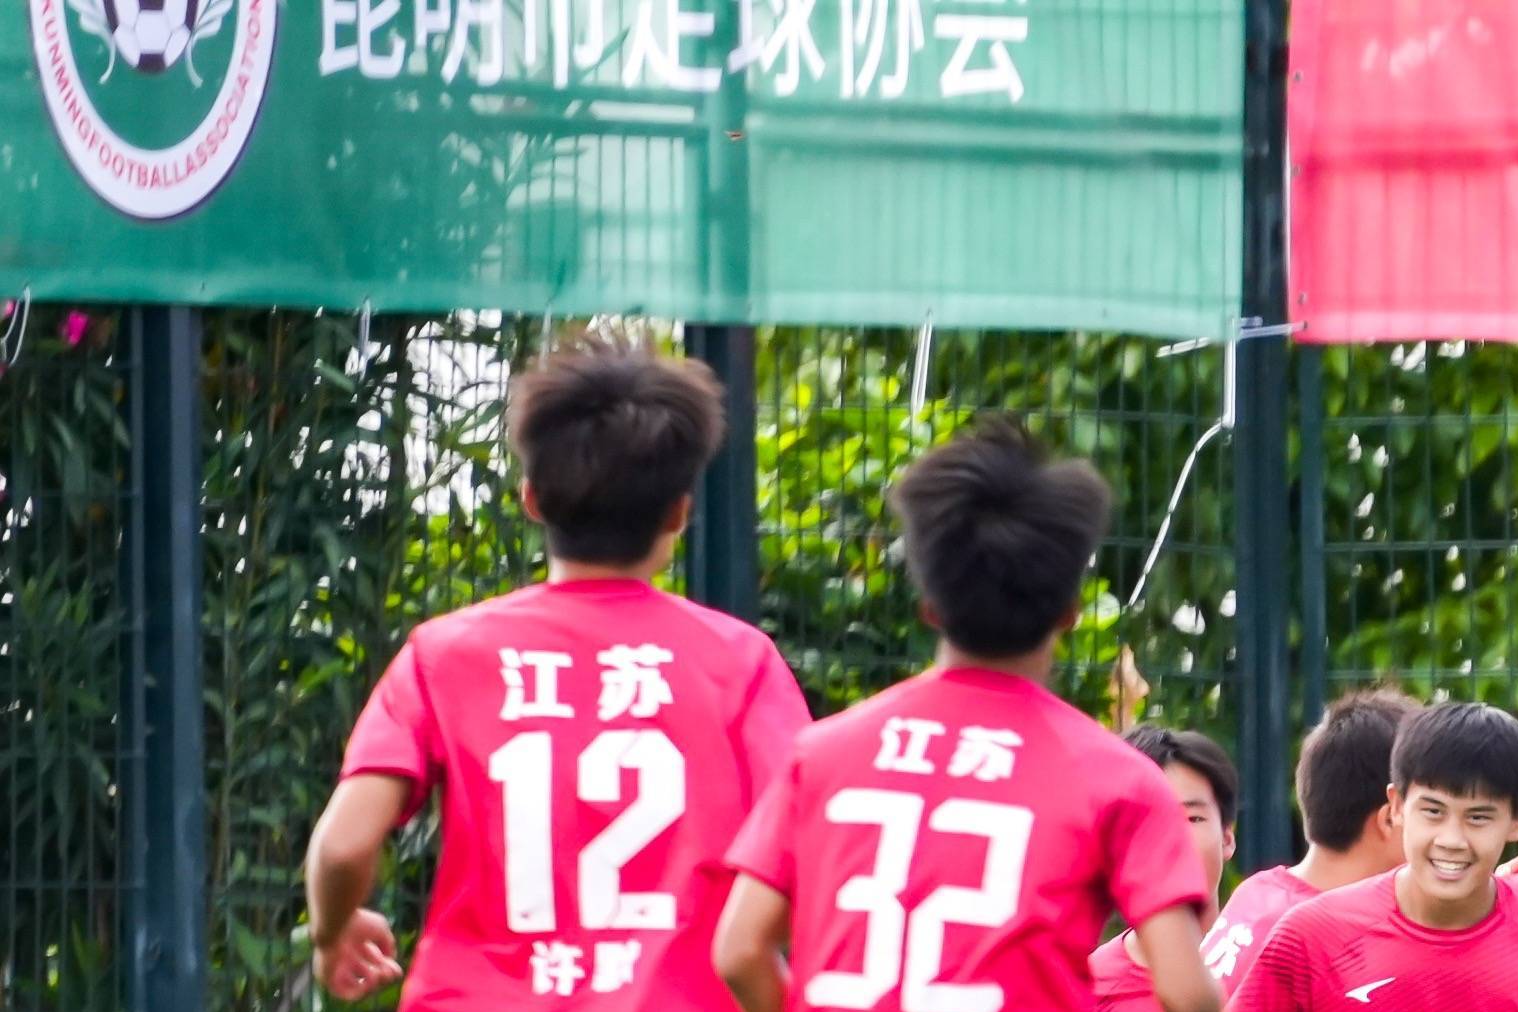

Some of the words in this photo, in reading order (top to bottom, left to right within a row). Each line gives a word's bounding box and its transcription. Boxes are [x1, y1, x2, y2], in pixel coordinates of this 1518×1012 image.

[499, 643, 674, 720] 江苏
[873, 716, 1024, 781] 江苏
[488, 729, 686, 933] 12
